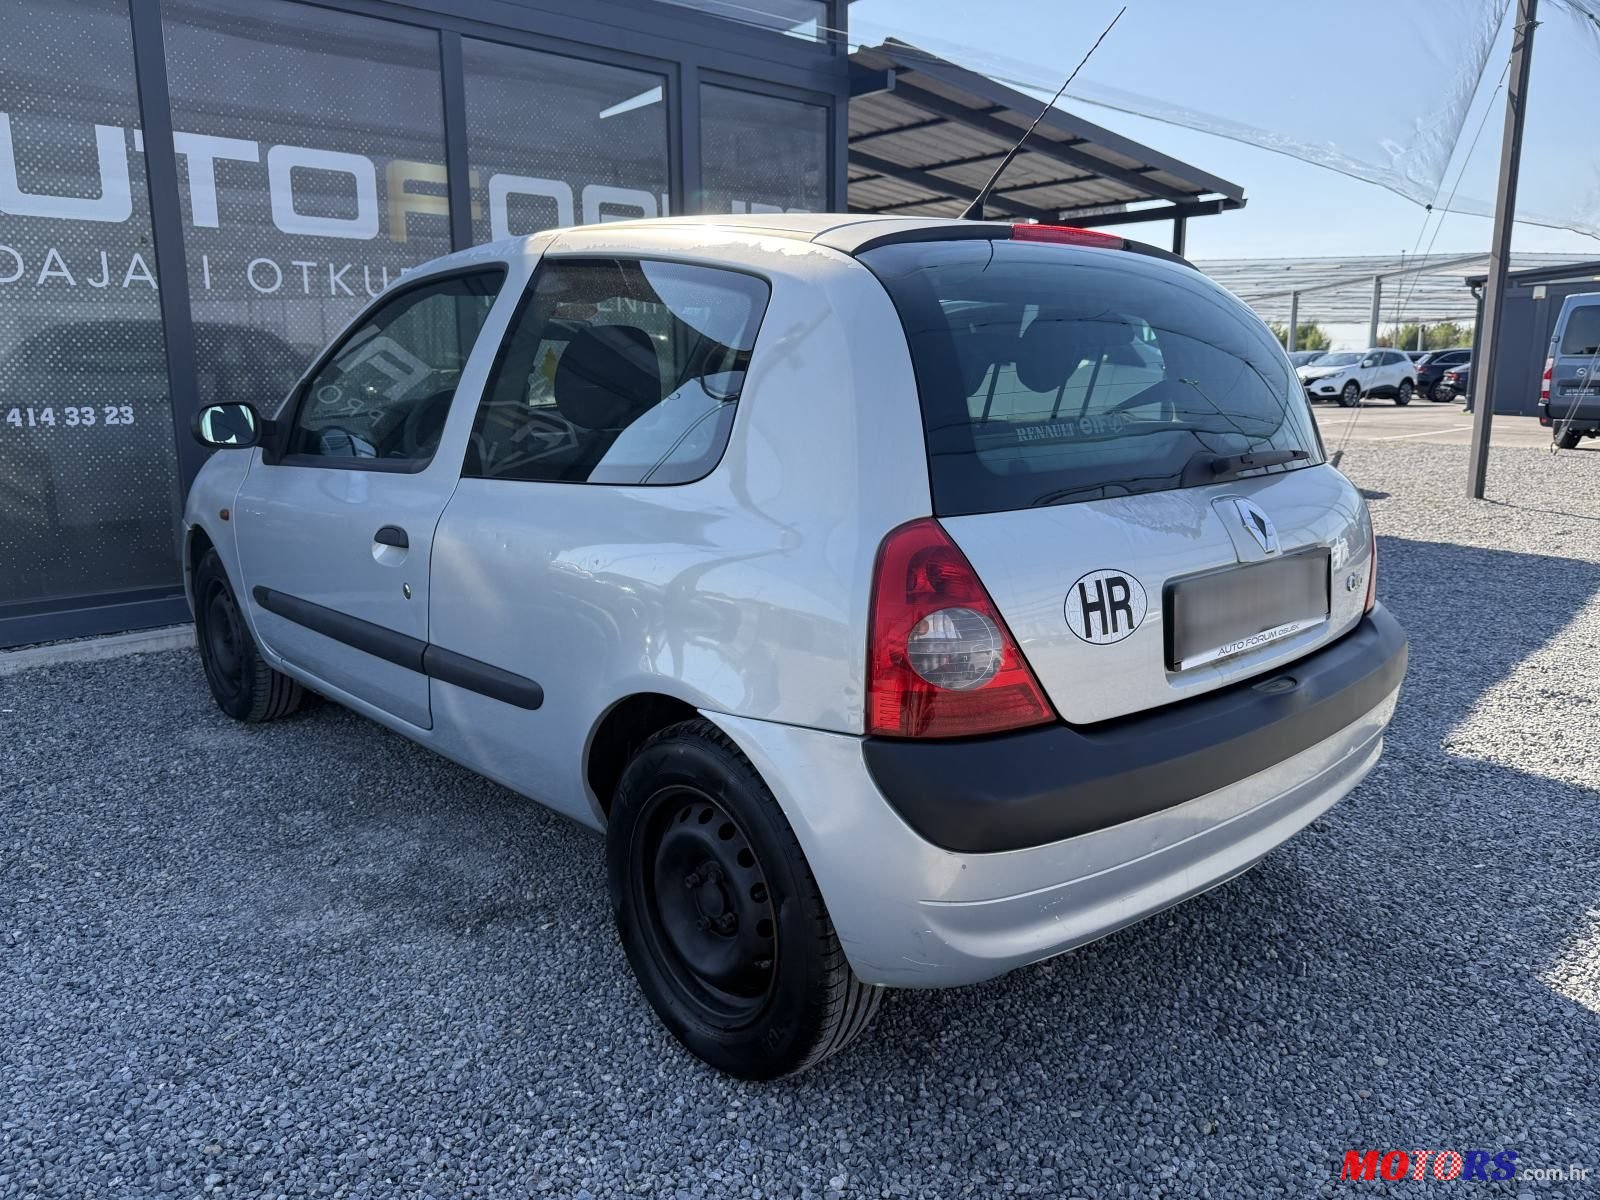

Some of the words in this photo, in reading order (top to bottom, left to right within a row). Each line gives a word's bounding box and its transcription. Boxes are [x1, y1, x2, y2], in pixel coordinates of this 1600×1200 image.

[203, 255, 211, 290] I
[247, 257, 412, 298] OTKU
[6, 407, 56, 427] 414
[64, 406, 96, 426] 33
[104, 406, 135, 425] 23
[1016, 423, 1074, 442] RENAULT
[1077, 576, 1135, 639] HR
[1217, 641, 1244, 656] AUTO
[1245, 630, 1277, 647] FORUM
